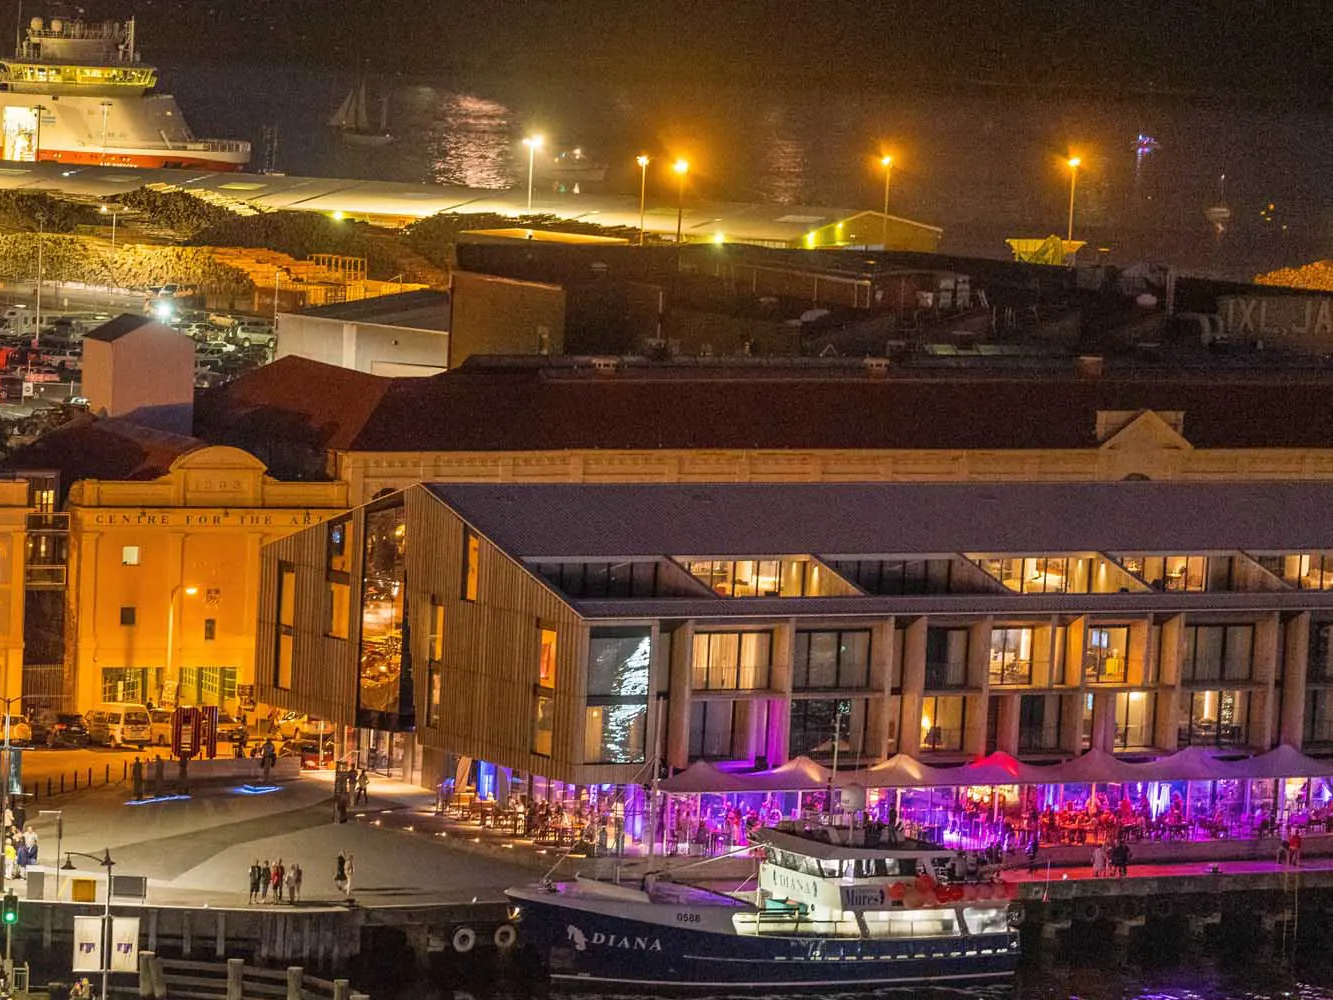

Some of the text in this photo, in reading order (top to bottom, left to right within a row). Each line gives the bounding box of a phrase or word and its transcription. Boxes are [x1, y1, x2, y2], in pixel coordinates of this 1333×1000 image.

[96, 514, 170, 525] CENTRE
[186, 514, 221, 525] FOR
[240, 514, 272, 525] THE
[779, 876, 811, 895] DIANA
[846, 889, 878, 906] Mures
[592, 932, 663, 951] DIANA
